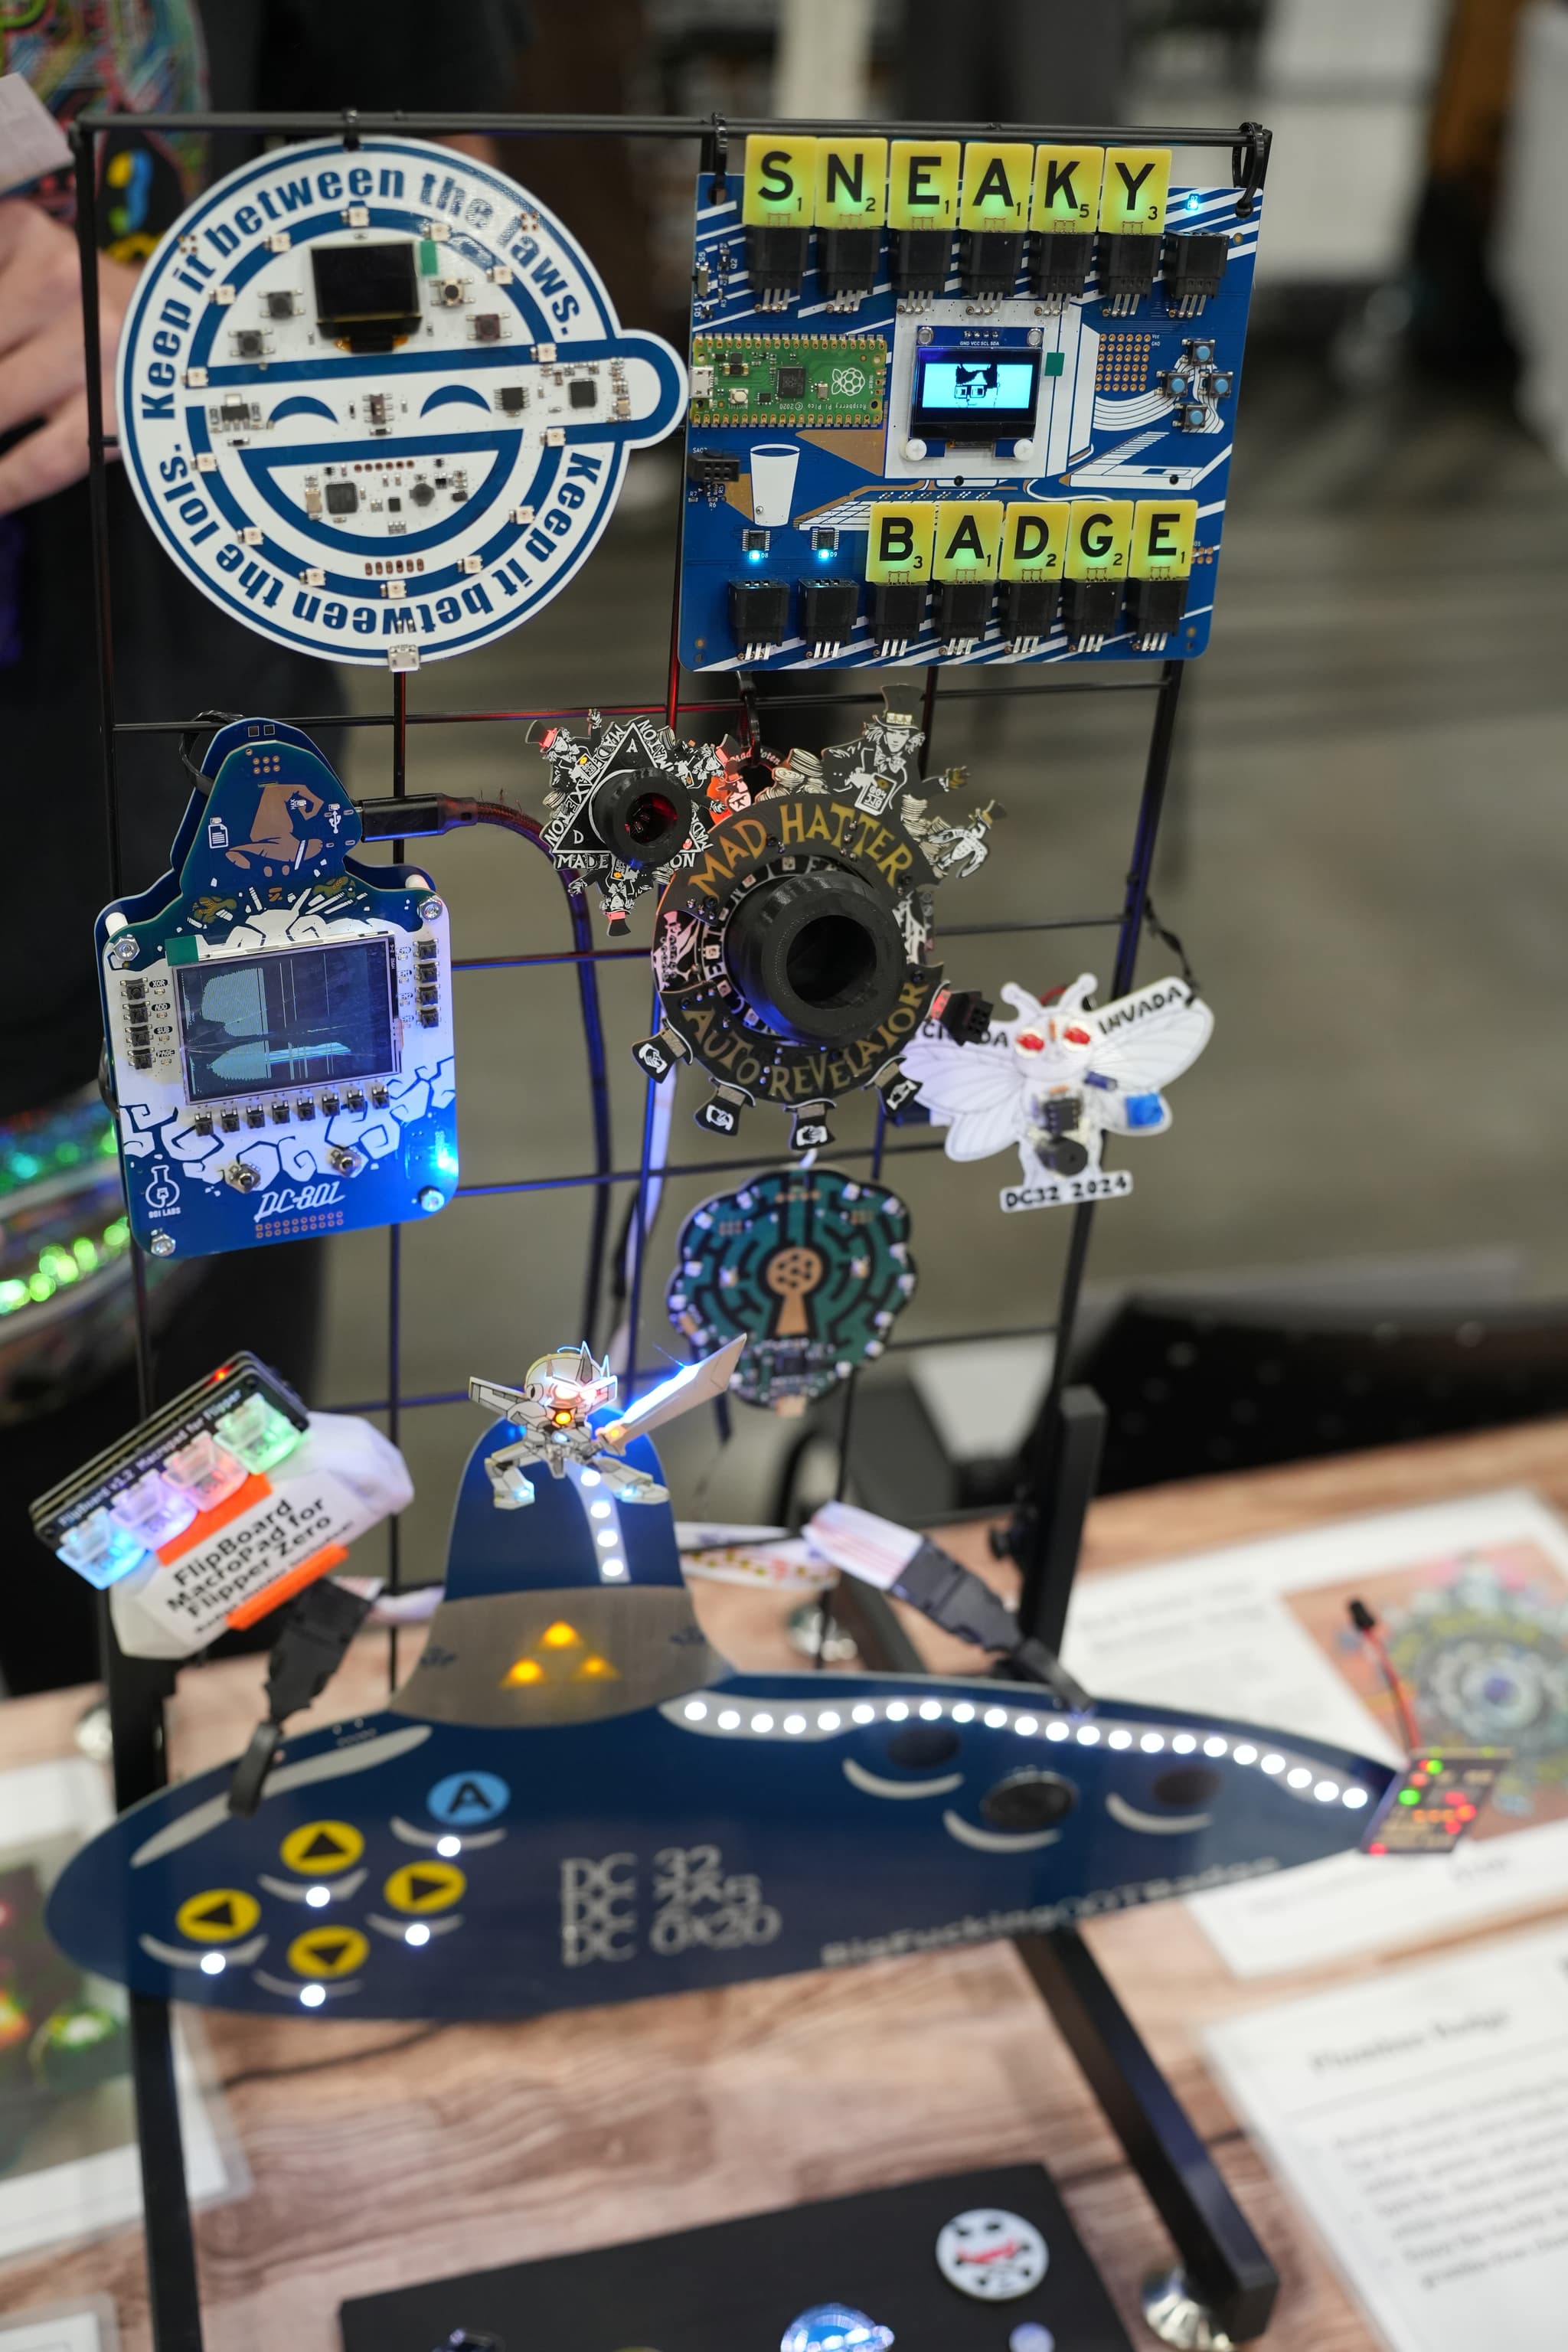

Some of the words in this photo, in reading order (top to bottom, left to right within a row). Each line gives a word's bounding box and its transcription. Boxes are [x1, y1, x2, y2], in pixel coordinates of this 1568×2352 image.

[141, 288, 194, 420] Keep
[172, 250, 216, 292] it
[207, 165, 405, 257] between
[420, 172, 494, 230] the
[496, 228, 583, 336] laws.
[158, 443, 221, 543] lols.
[518, 449, 603, 574] Keep
[214, 541, 281, 610] the
[489, 555, 532, 598] it
[879, 513, 1181, 562] BADGE
[292, 576, 496, 635] between
[689, 818, 768, 899] MAD
[779, 802, 913, 889] HATTER
[683, 1008, 760, 1086] AUTO
[923, 1024, 1009, 1047] CIDA
[1099, 986, 1182, 1035] INVADA
[1005, 1186, 1060, 1209] DC32
[1073, 1177, 1127, 1200] 2024
[165, 1524, 287, 1615] MacroPad
[287, 1495, 328, 1530] for
[172, 1497, 295, 1591] FlipBoard
[186, 1553, 274, 1622] Flipper
[274, 1512, 334, 1560] Zero
